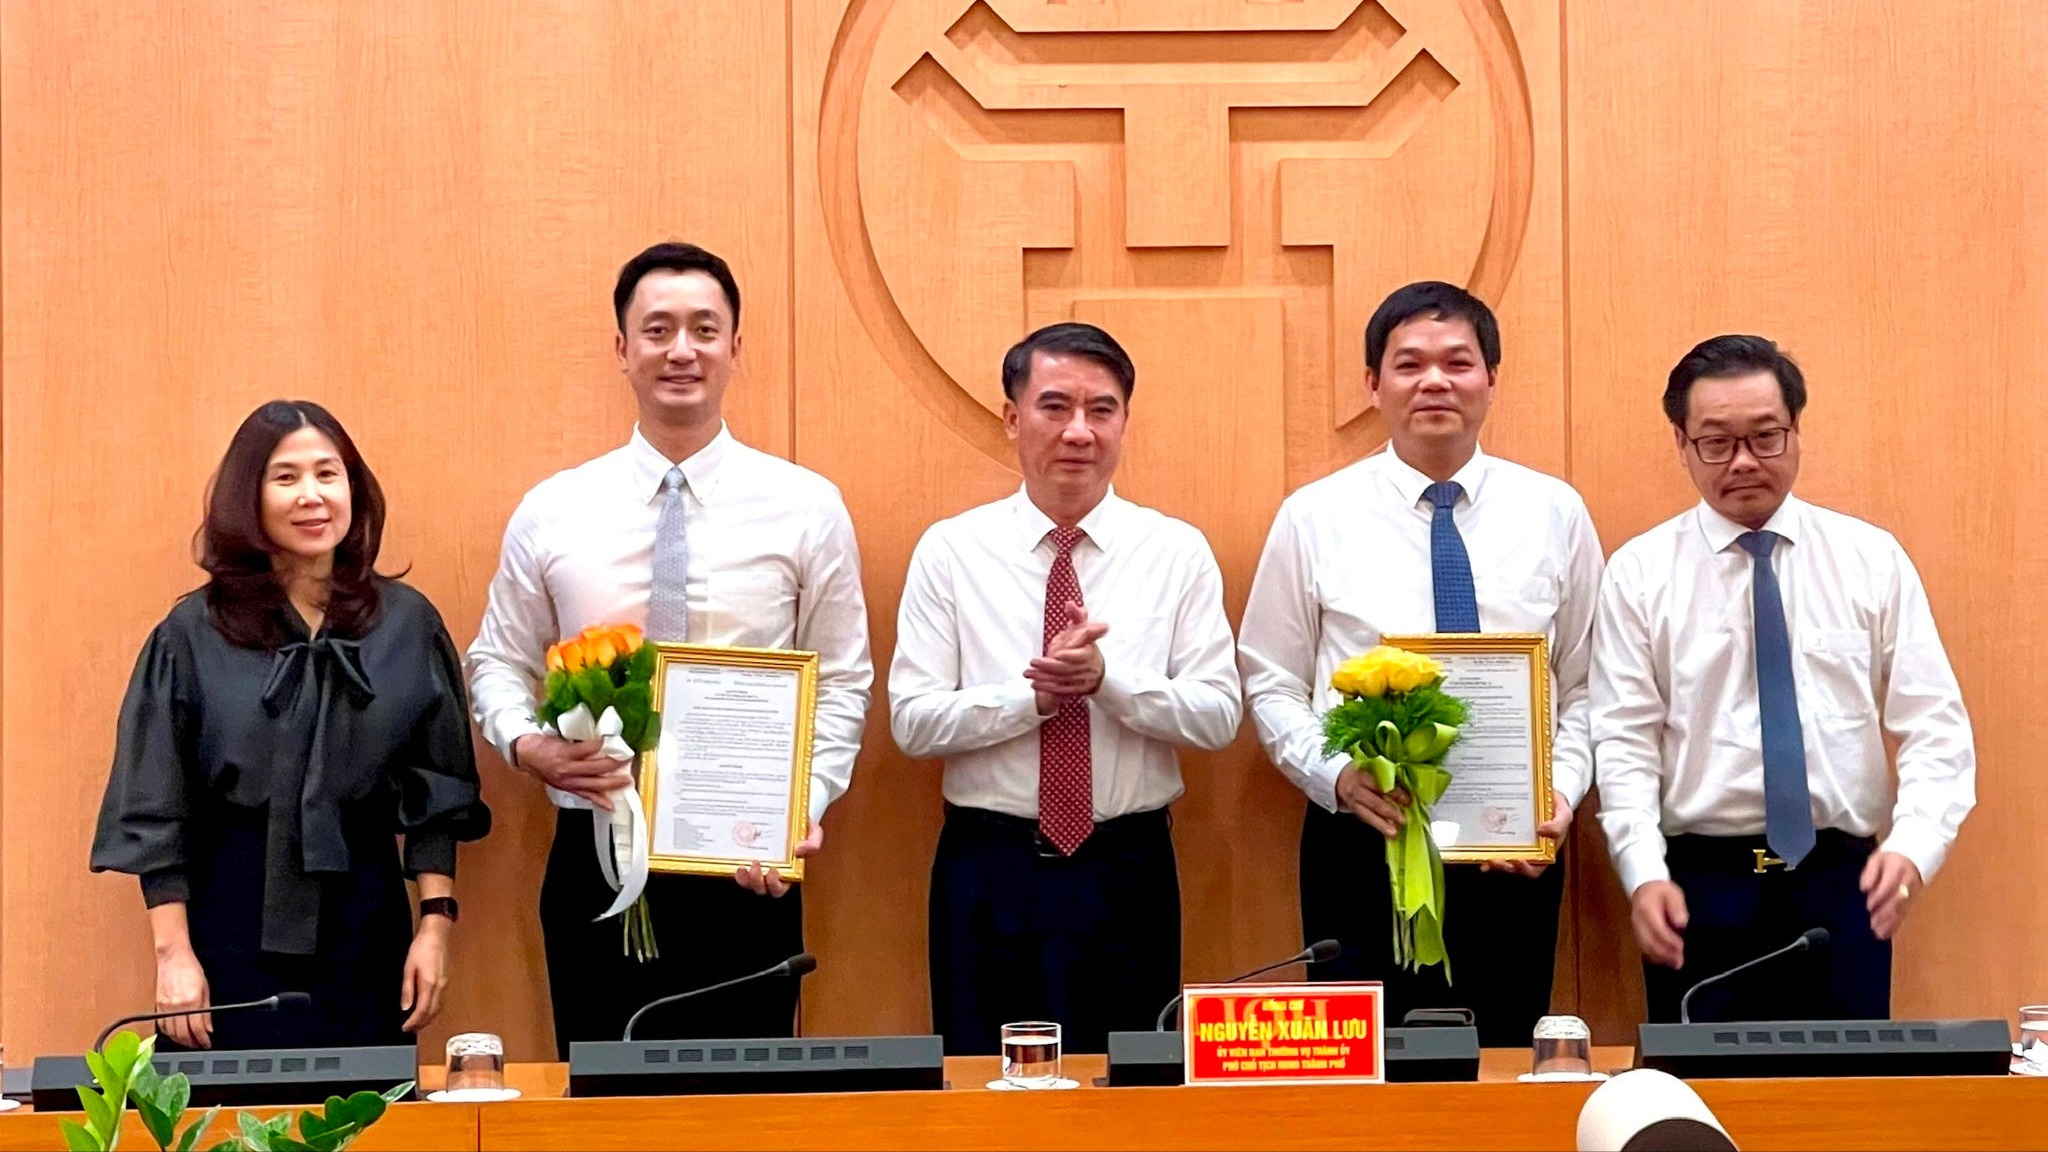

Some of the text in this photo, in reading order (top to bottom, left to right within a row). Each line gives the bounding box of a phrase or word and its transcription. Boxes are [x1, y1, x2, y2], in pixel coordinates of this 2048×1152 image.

[1199, 1013, 1367, 1042] NGUYỄN XUÂN LƯU
